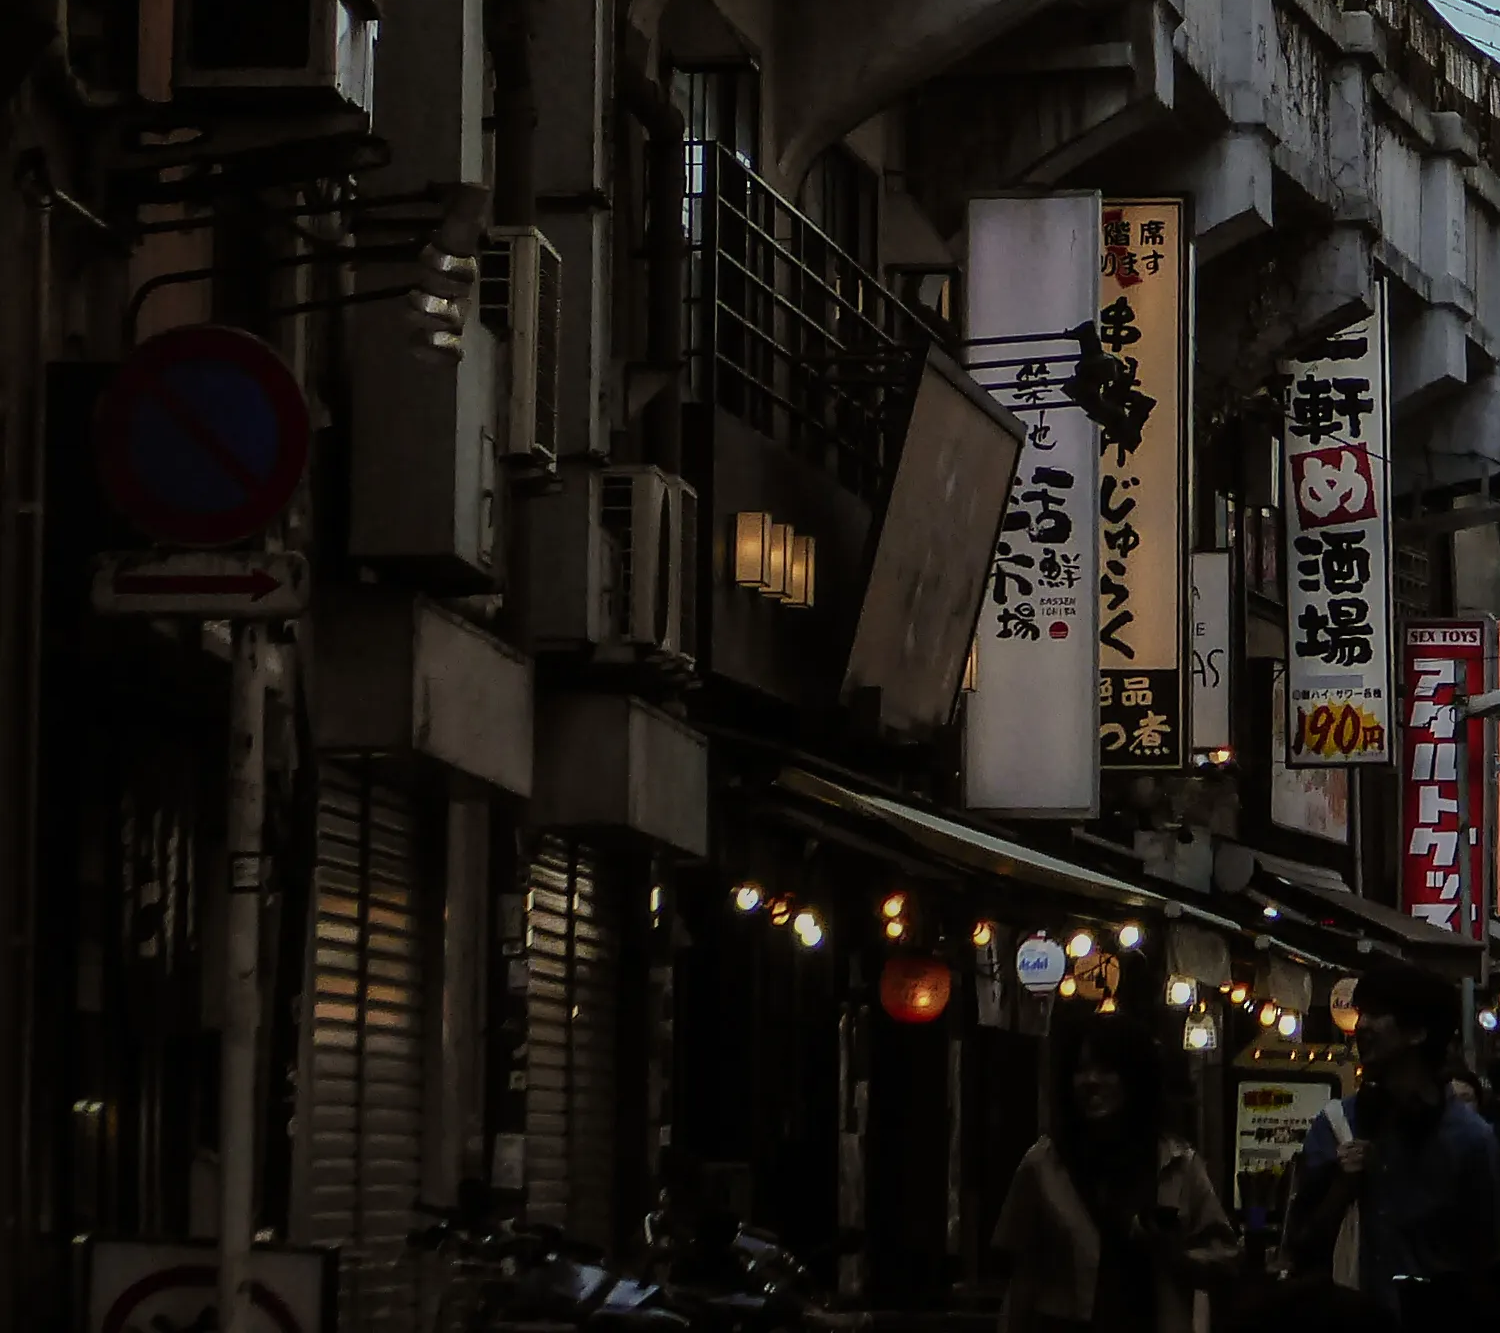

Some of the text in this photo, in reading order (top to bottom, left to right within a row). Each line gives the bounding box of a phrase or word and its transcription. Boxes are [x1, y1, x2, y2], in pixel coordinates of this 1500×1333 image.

[1410, 630, 1478, 644] SEX TOYS
[1292, 704, 1385, 755] 190円
